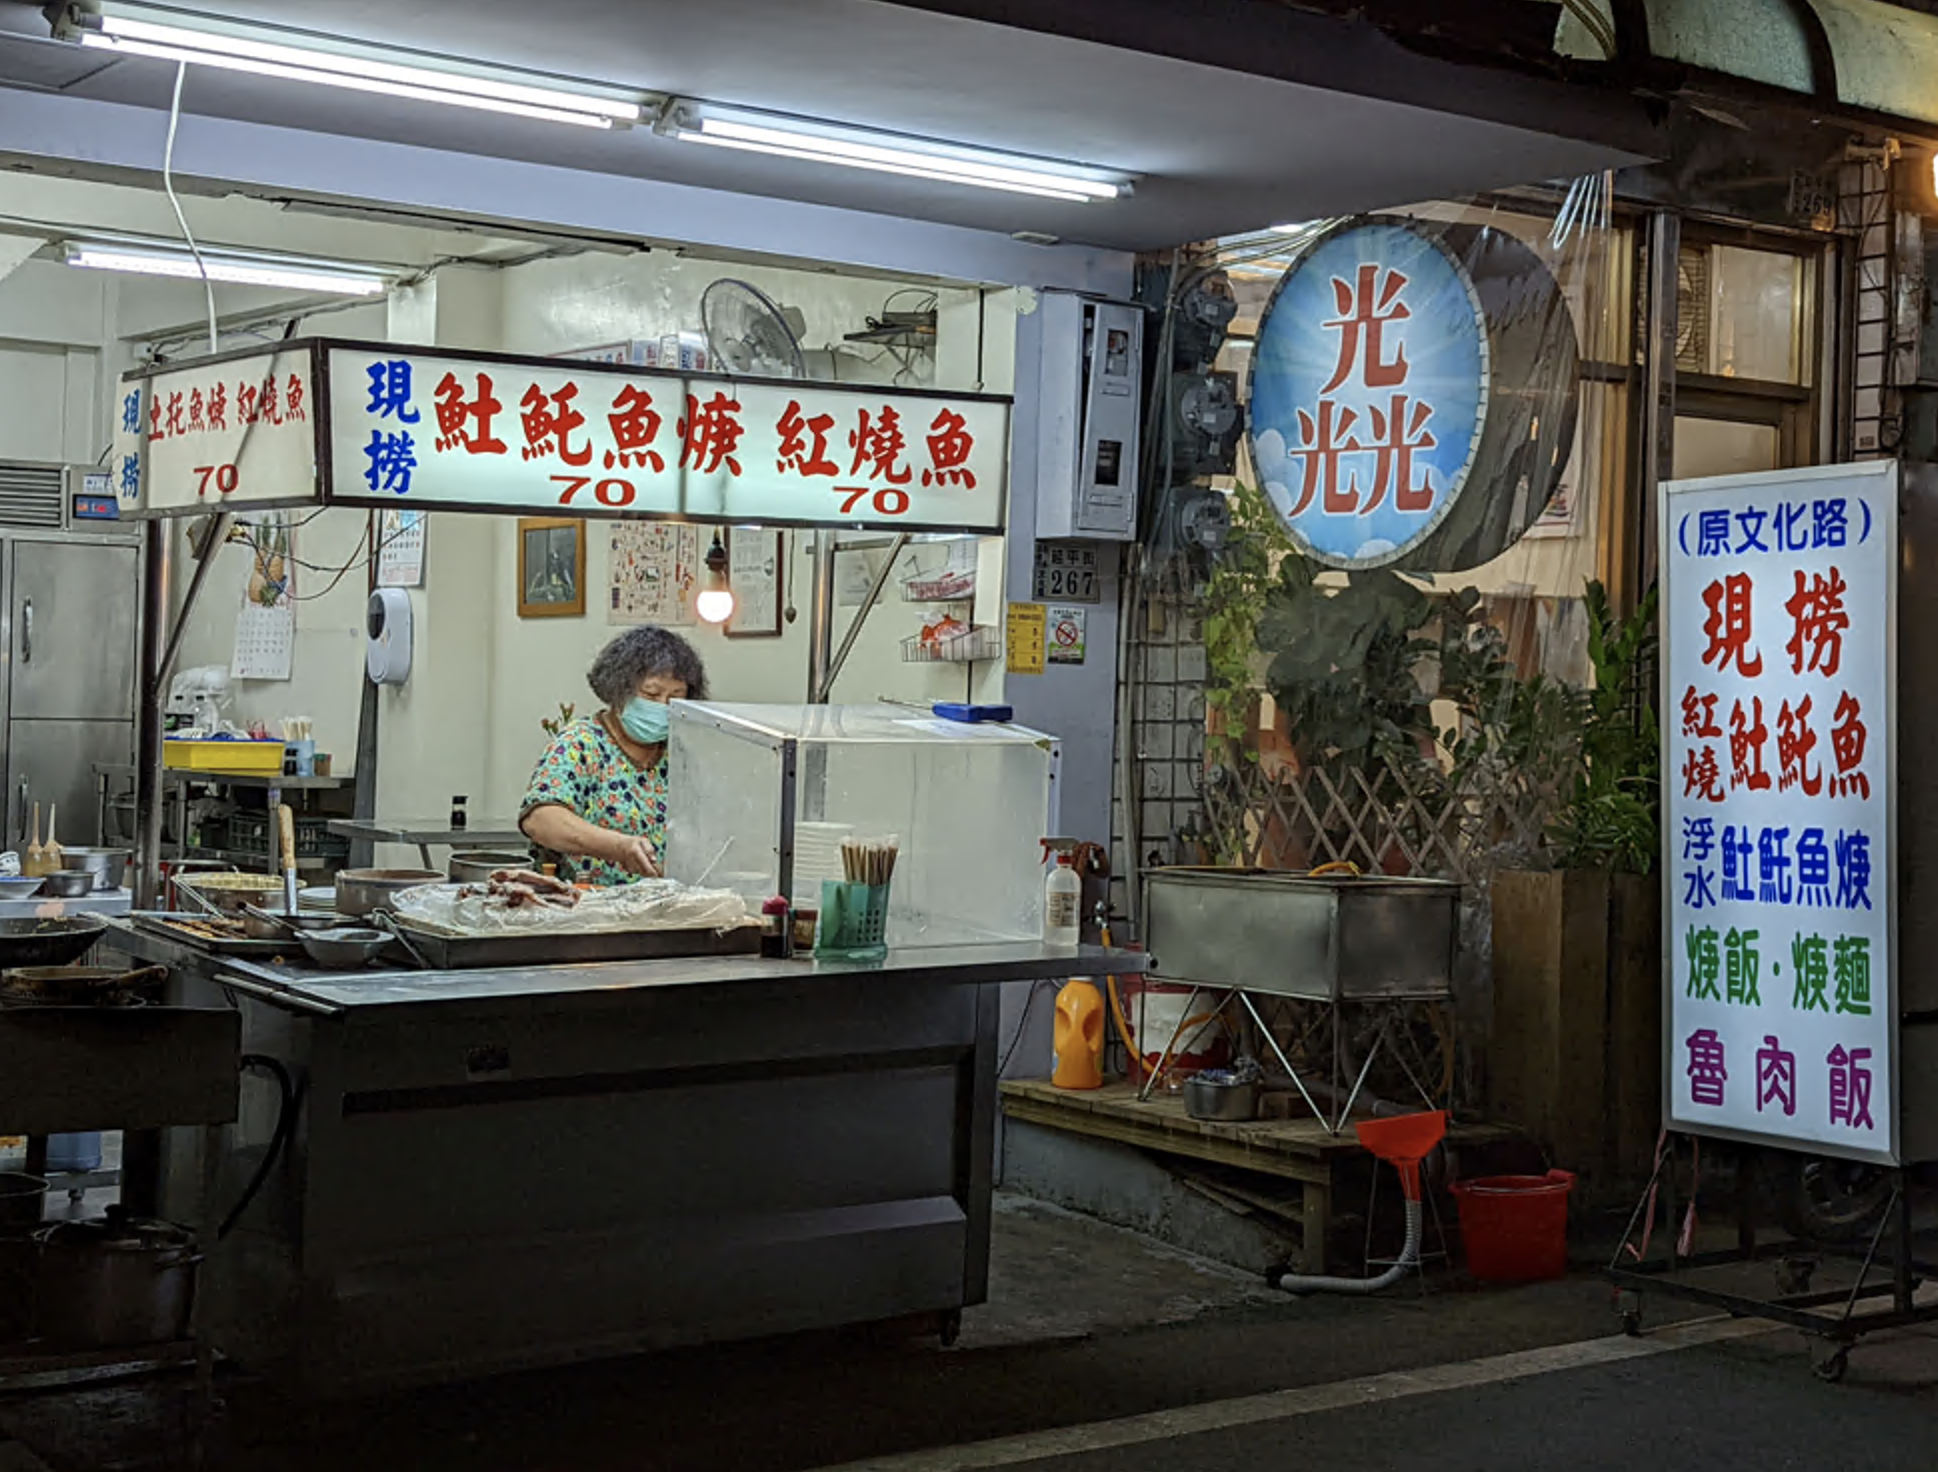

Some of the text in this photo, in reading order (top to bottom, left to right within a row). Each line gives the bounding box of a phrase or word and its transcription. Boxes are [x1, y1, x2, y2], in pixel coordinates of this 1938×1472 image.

[1320, 265, 1411, 394] 光
[237, 373, 306, 425] 紅燒魚
[363, 359, 422, 496] 現撈
[776, 400, 977, 489] 紅燒魚
[194, 464, 239, 496] 70
[549, 475, 911, 515] 70 70
[1288, 394, 1437, 517] 光光
[1051, 569, 1093, 596] 267
[1681, 685, 1726, 803] 紅燒
[1686, 1028, 1874, 1130] 魯肉飯
